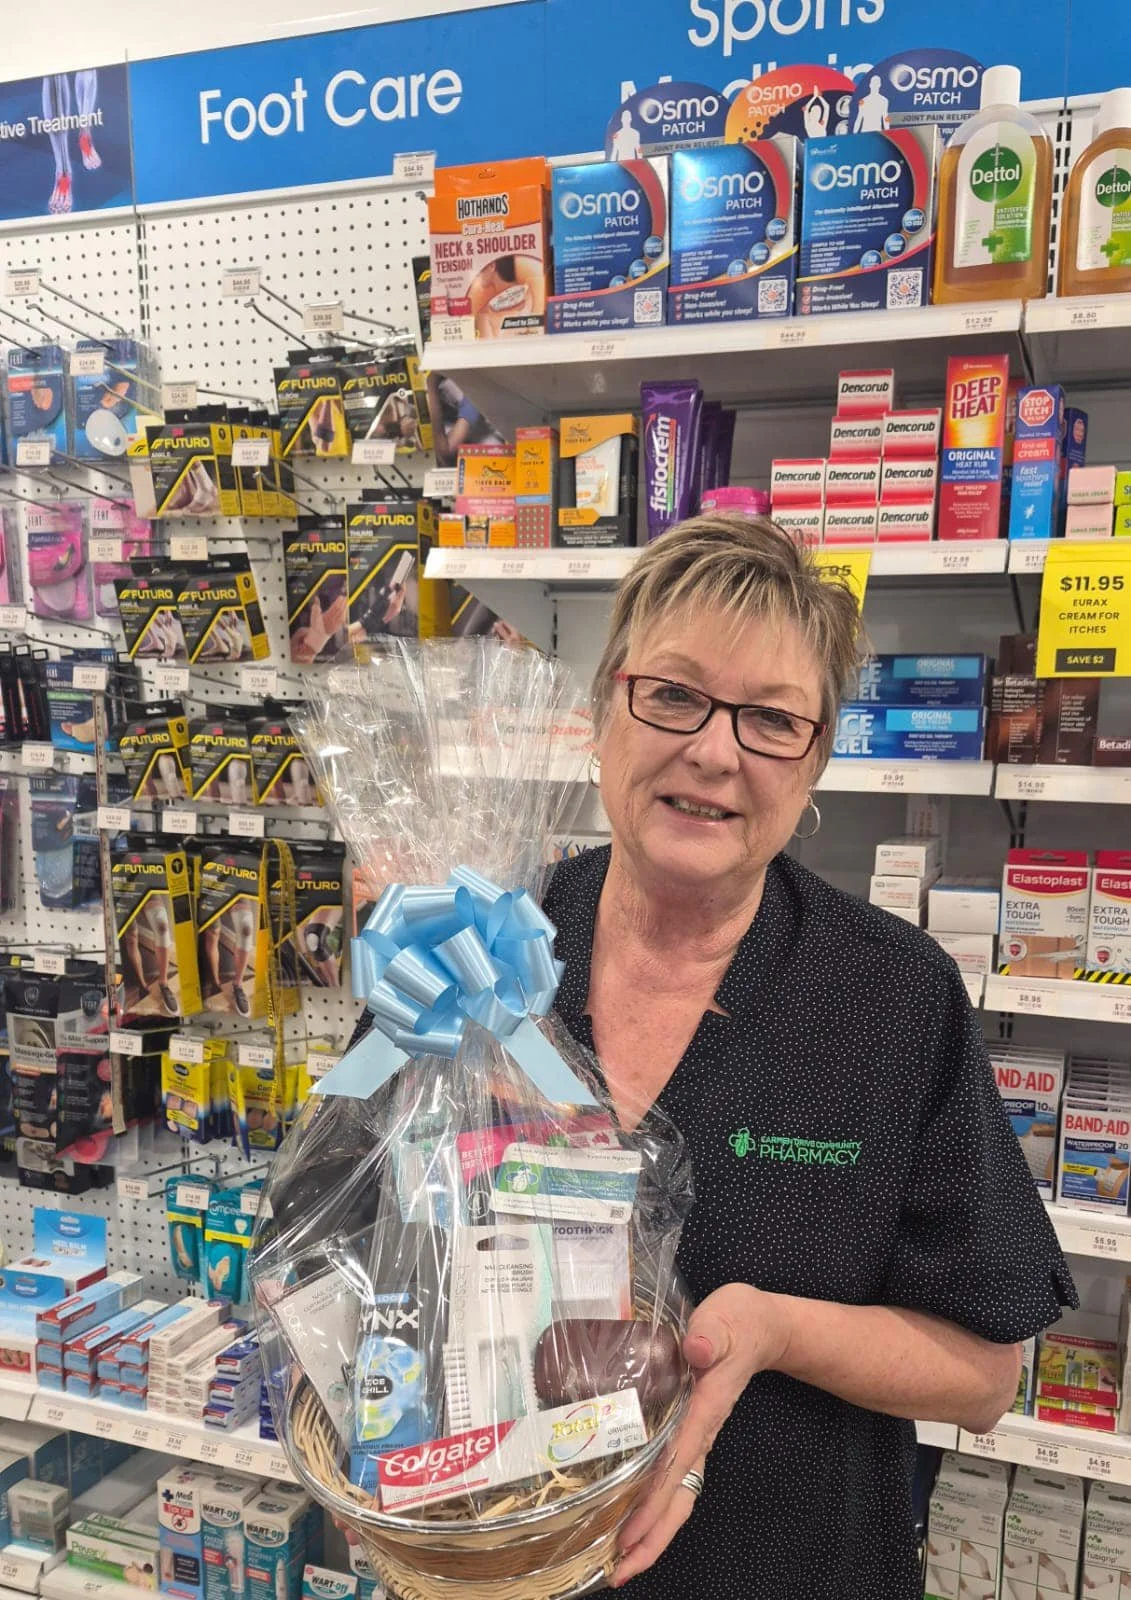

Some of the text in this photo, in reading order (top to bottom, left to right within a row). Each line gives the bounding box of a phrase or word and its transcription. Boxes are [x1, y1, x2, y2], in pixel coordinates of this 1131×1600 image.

[914, 92, 961, 105] PATCH
[200, 66, 463, 144] Foot Care
[748, 103, 786, 117] PATCH
[27, 108, 103, 135] Treatment
[901, 114, 925, 122] JOINT
[662, 121, 705, 136] PATCH
[972, 164, 1020, 185] Dettol
[860, 187, 899, 200] PATCH
[457, 194, 509, 221] HOTHANDS
[725, 198, 762, 210] PATCH
[604, 215, 639, 228] PATCH
[435, 234, 536, 259] NECK & SHOULDER
[436, 259, 472, 274] TENSION
[290, 377, 336, 390] FUTURO
[358, 373, 407, 388] FUTURO
[841, 382, 889, 393] Dencorub
[953, 376, 1001, 401] DEEP
[952, 394, 999, 419] HEAT
[1025, 396, 1049, 407] STOP
[1023, 406, 1049, 417] ITCH
[833, 427, 880, 439] Dencorub
[886, 422, 935, 433] Dencorub
[164, 437, 210, 449] FUTURO
[948, 450, 997, 461] ORIGINAL
[1018, 449, 1050, 458] cream
[650, 416, 672, 512] fisiocrem
[774, 471, 821, 482] Dencorub
[828, 471, 876, 481] Dencorub
[885, 468, 933, 479] Dencorub
[1020, 467, 1038, 475] fast
[365, 514, 415, 526] FUTURO
[827, 515, 874, 526] Dencorub
[881, 512, 929, 523] Dencorub
[300, 541, 345, 553] FUTURO
[1060, 575, 1125, 592] $11.95
[131, 589, 174, 600] FUTURO
[190, 588, 237, 601] FUTURO
[1073, 598, 1108, 608] EURAX
[1059, 611, 1120, 621] CREAM FOR
[1069, 625, 1107, 635] ITCHES
[1067, 655, 1104, 665] SAVE $2
[911, 711, 952, 720] ORIGINAL
[128, 733, 170, 746] FUTURO
[204, 735, 247, 748] FUTURO
[833, 735, 873, 755] GEL
[125, 864, 164, 874] FUTURO
[216, 865, 257, 881] FUTURO
[1012, 873, 1083, 887] Elastoplast
[1006, 901, 1040, 911] EXTRA
[1093, 906, 1128, 916] EXTRA
[1006, 910, 1041, 920] TOUGH
[1092, 915, 1130, 926] TOUGH
[993, 1067, 1055, 1093] ND-AID
[1037, 1102, 1049, 1111] 10
[1065, 1114, 1130, 1136] BAND-AID
[816, 1139, 863, 1150] COMMUNITY
[759, 1144, 861, 1165] PHARMACY
[551, 1416, 598, 1439] Total
[384, 1434, 491, 1476] Colgate
